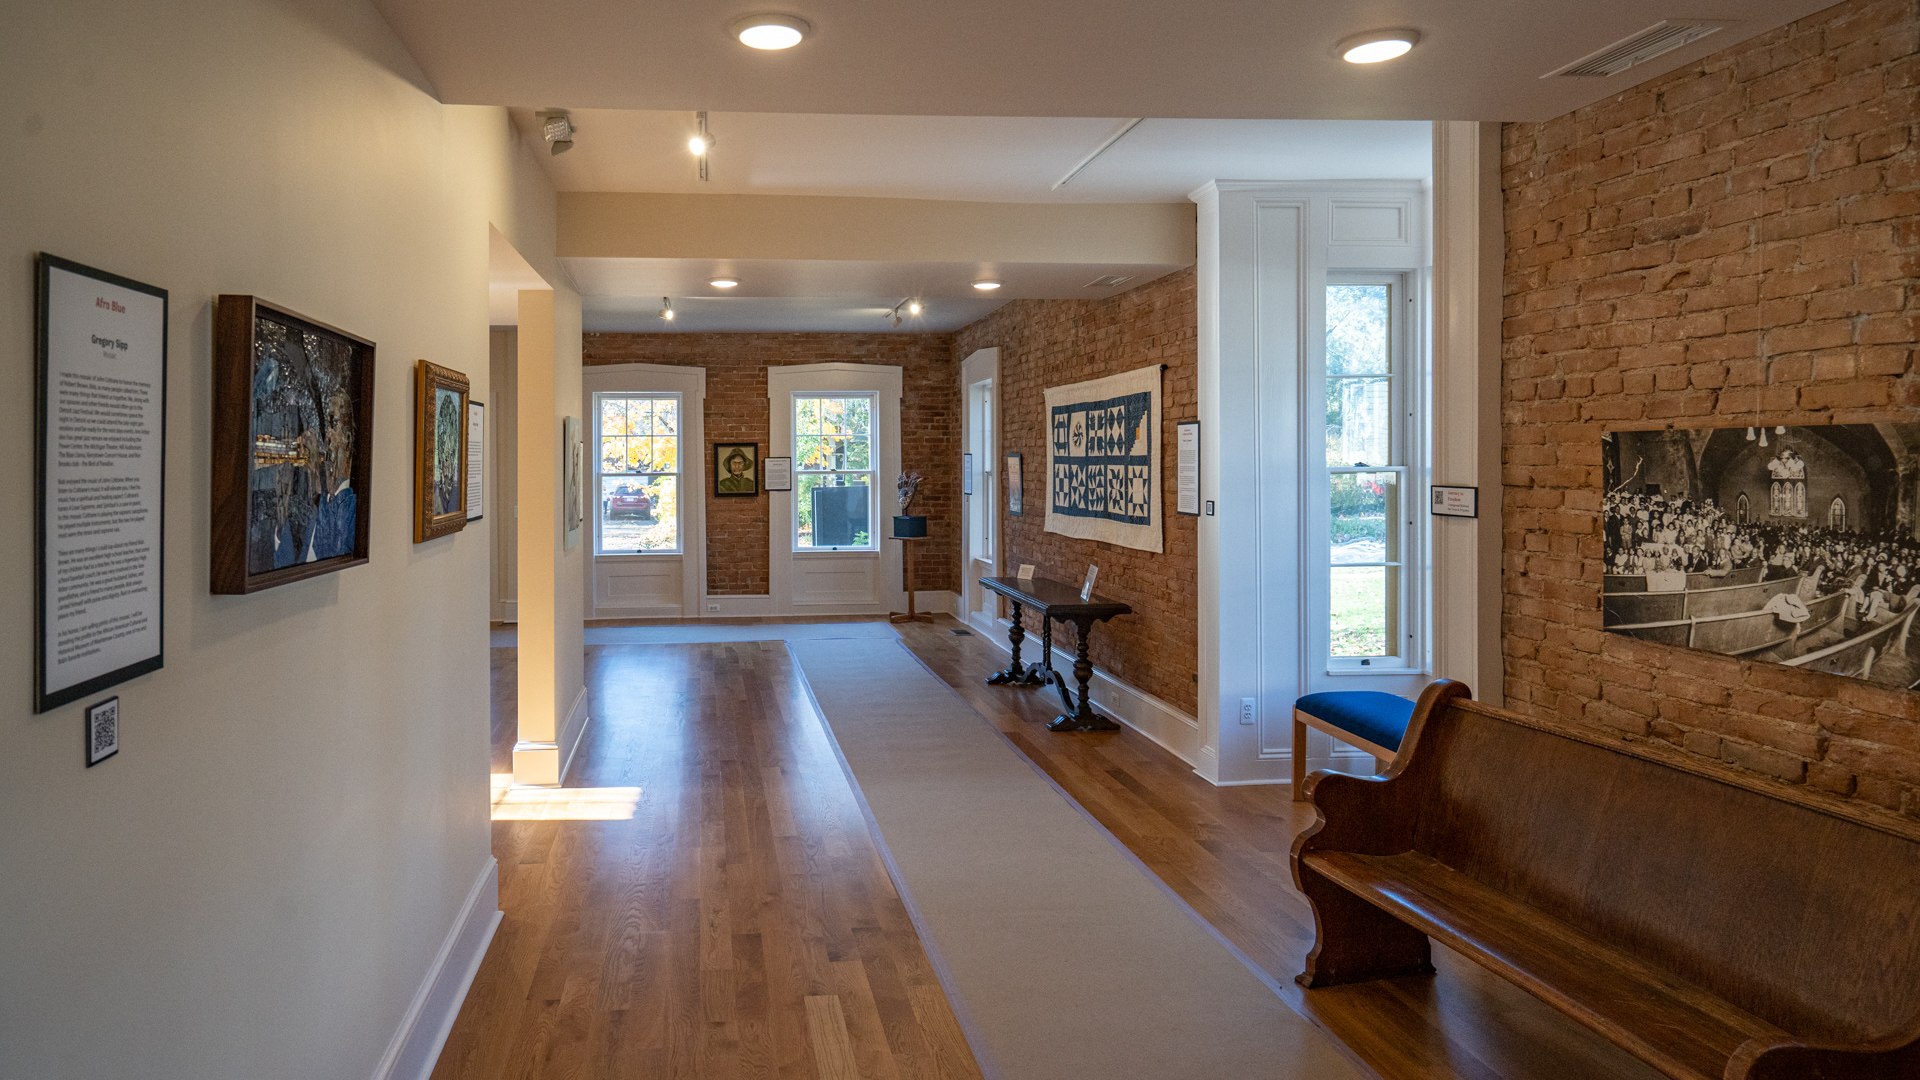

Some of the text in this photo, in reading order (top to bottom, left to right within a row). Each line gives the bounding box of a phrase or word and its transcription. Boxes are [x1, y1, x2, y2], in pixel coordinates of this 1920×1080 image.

[96, 297, 126, 314] Afro Blue
[92, 334, 128, 352] Gregory Sipp
